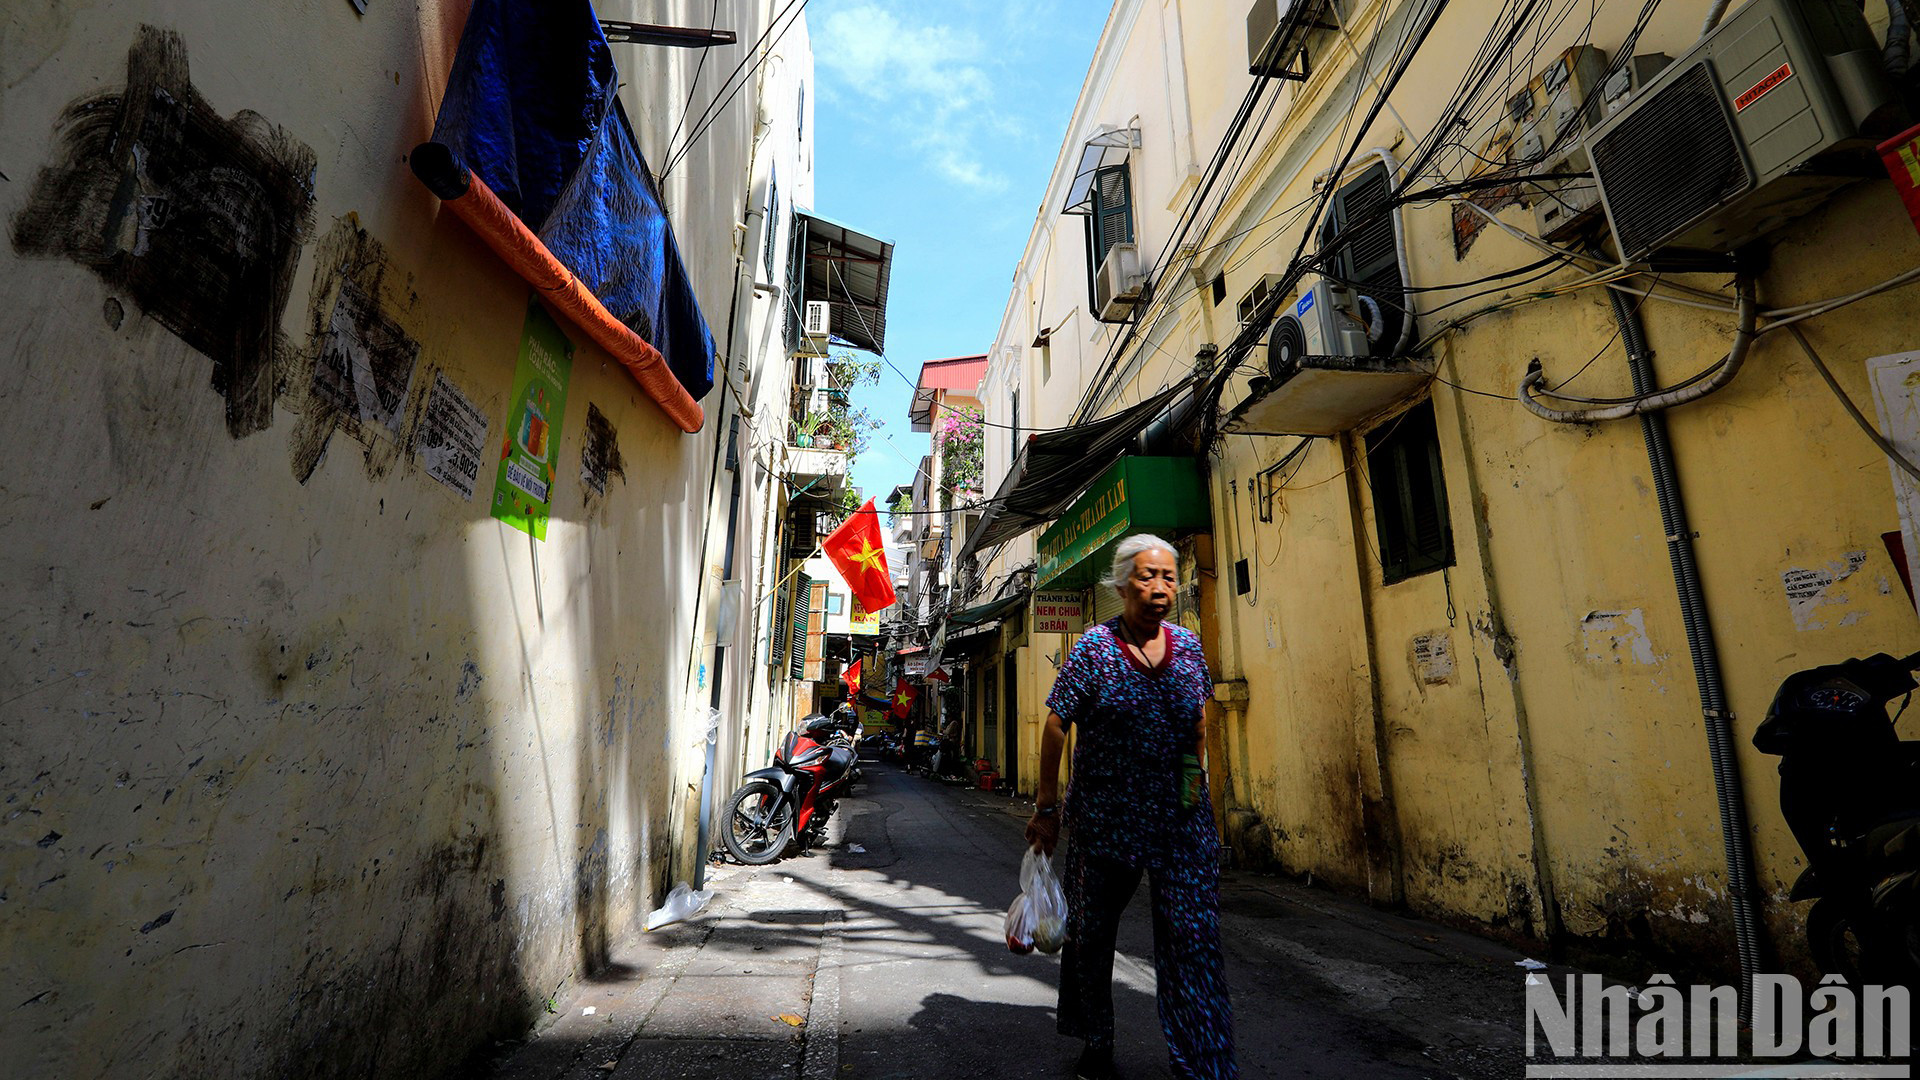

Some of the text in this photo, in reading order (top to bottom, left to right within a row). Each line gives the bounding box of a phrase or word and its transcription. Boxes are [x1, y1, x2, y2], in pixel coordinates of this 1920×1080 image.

[1740, 69, 1785, 105] HITACHI
[529, 348, 542, 370] LOẠI
[1037, 592, 1063, 602] THÀNH
[1036, 606, 1081, 617] NEM CHUA
[1039, 619, 1068, 630] 38 RÁN
